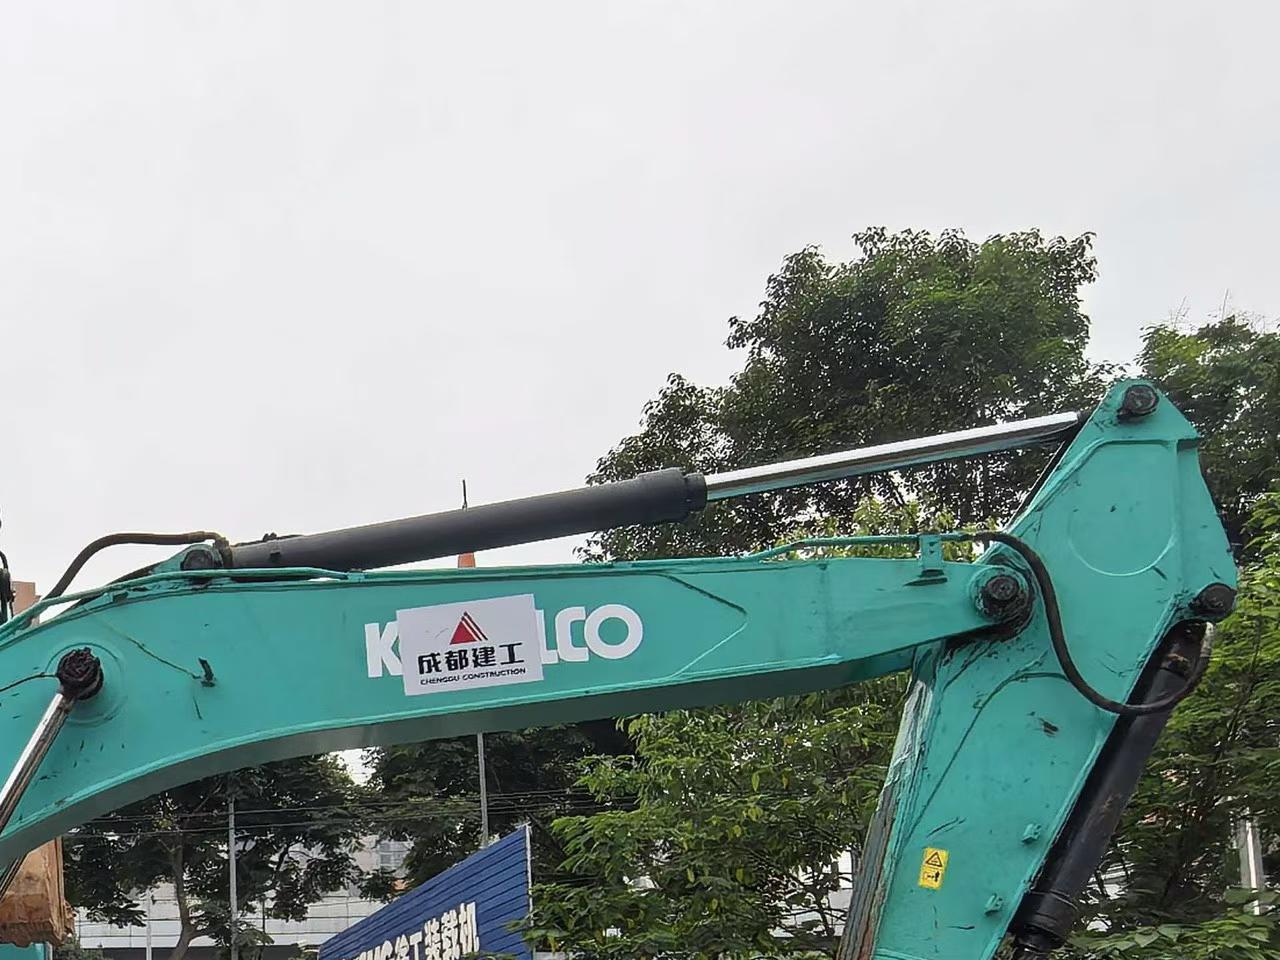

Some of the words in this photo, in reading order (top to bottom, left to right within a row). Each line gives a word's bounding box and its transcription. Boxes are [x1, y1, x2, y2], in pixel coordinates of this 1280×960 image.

[364, 604, 644, 678] KLCO
[417, 642, 525, 675] 成都建工
[420, 674, 460, 685] CHENGDU
[462, 667, 526, 681] CONSTRUCTION
